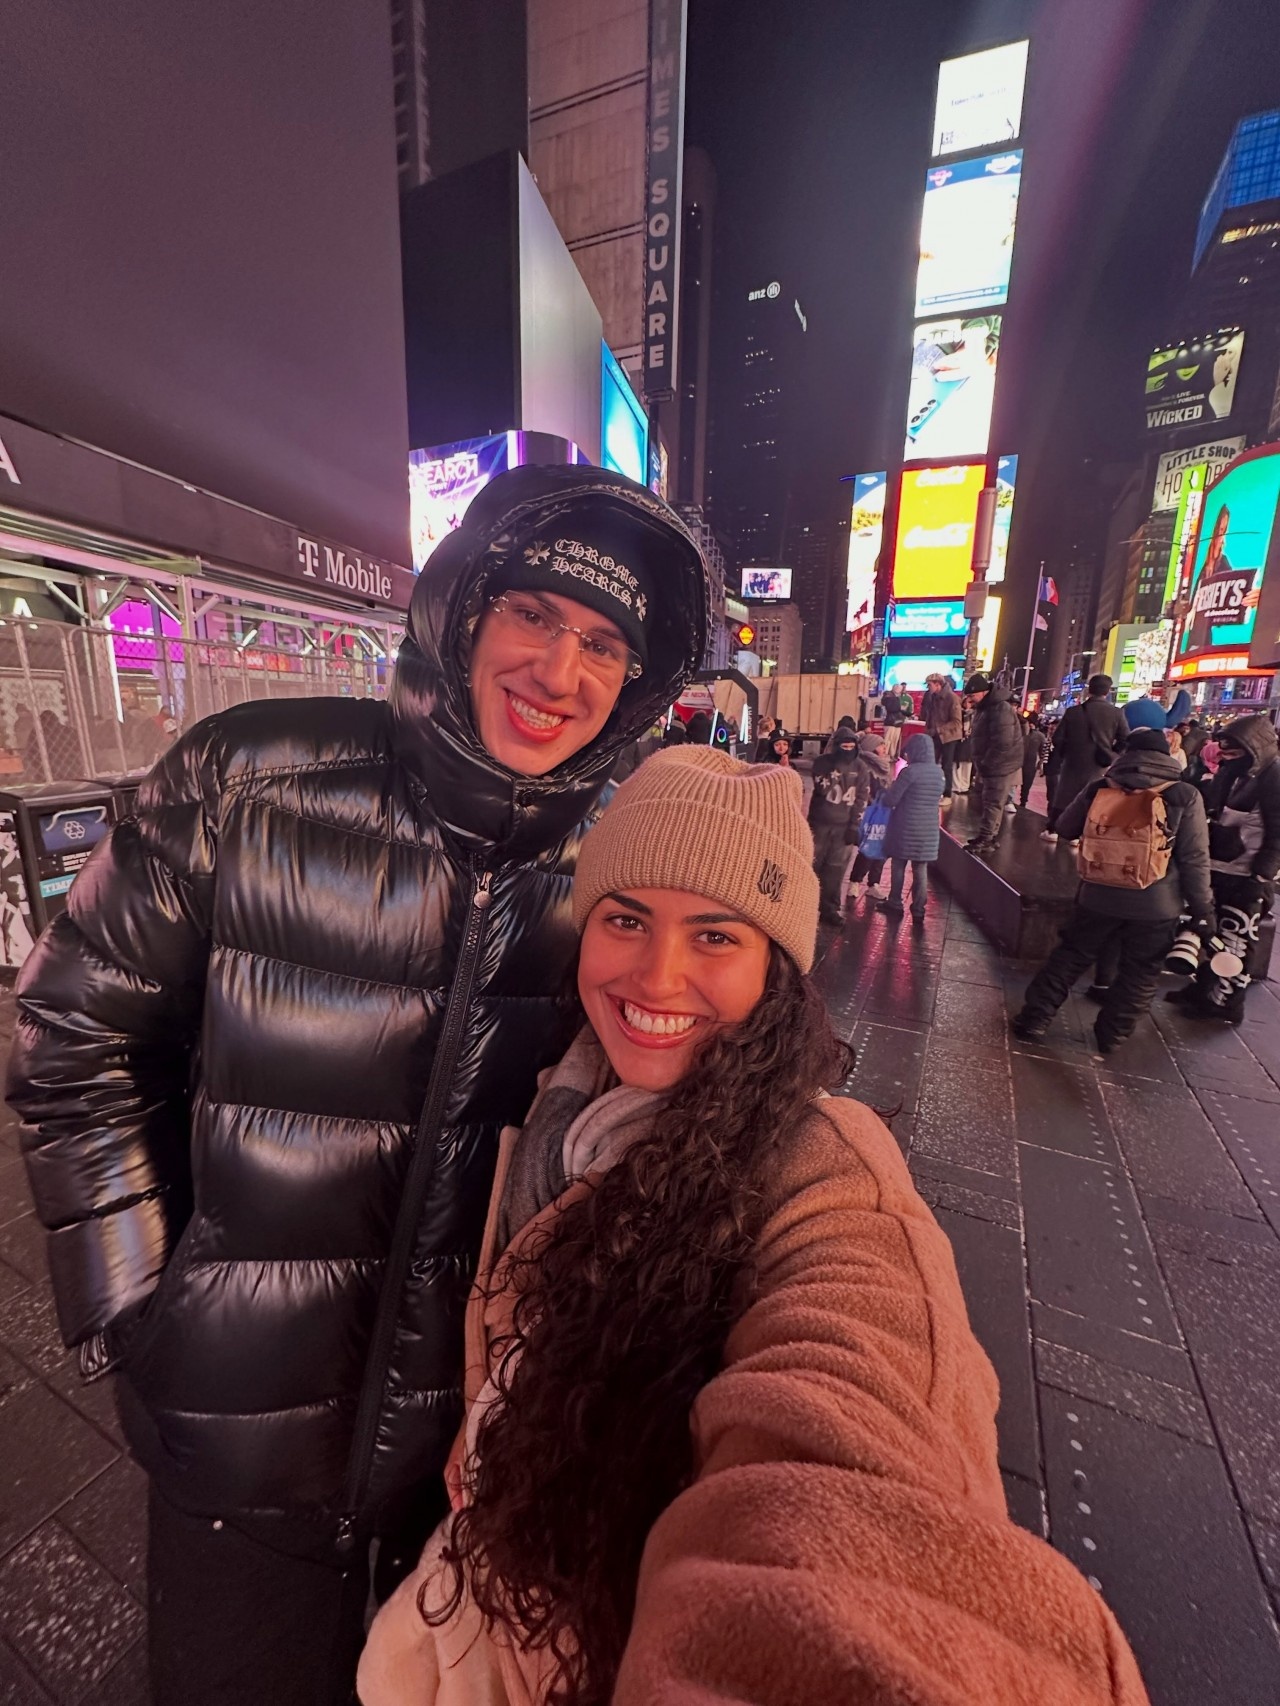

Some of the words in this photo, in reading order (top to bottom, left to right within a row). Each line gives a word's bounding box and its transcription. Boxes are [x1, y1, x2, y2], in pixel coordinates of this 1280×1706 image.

[652, 0, 675, 152] IMES
[648, 178, 670, 369] SQUARE
[1166, 447, 1206, 472] LITTLE
[1208, 446, 1236, 459] SHOP
[324, 546, 392, 599] Mobile
[550, 556, 632, 610] HEARTS
[555, 539, 639, 592] CHROME
